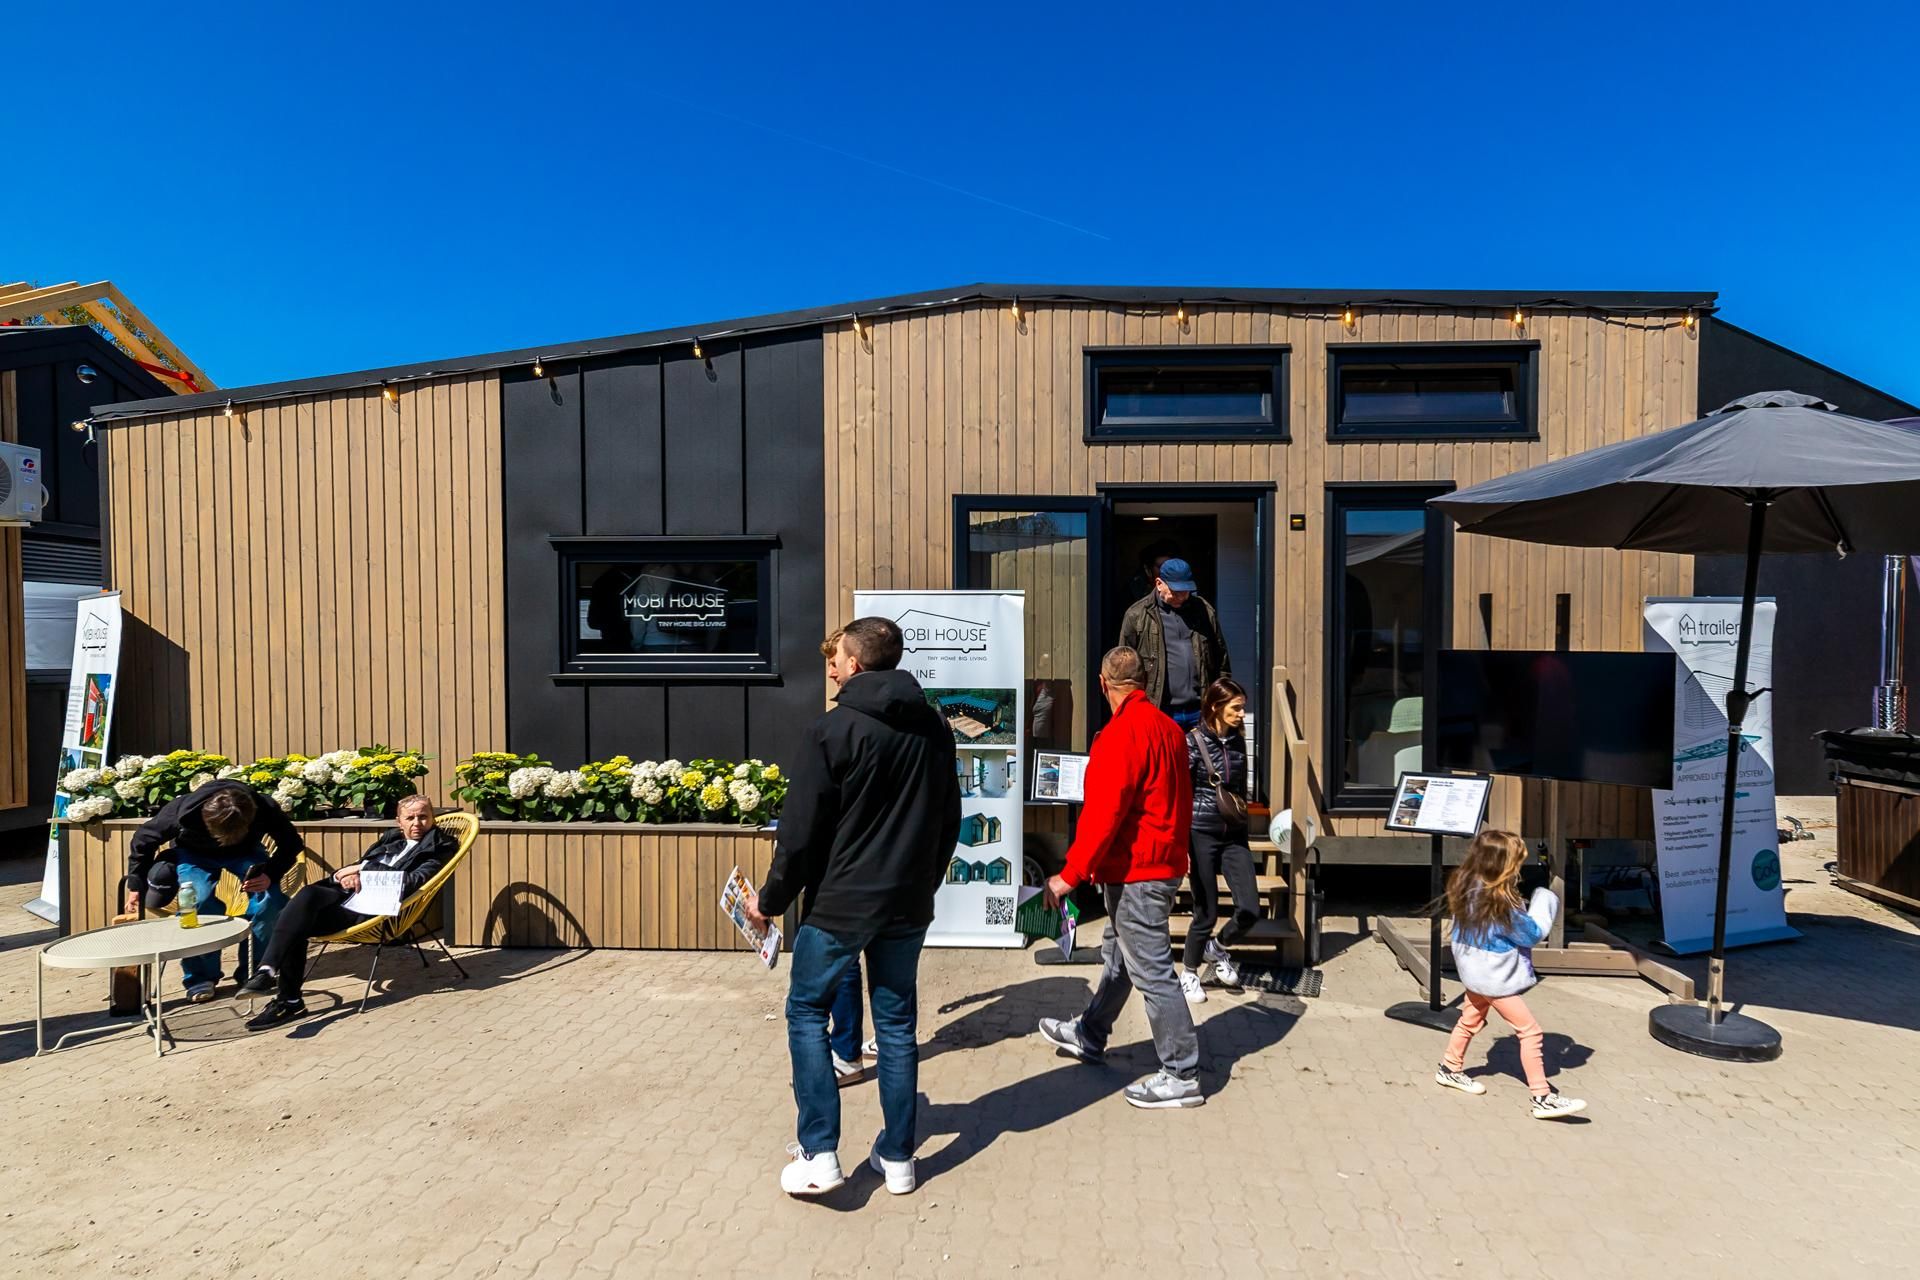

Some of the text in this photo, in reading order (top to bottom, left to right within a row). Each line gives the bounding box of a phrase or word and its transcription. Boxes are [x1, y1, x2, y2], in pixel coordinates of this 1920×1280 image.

[624, 594, 725, 608] MOBI HOUSE
[904, 628, 987, 641] OBI HOUSE
[1739, 769, 1764, 778] SYSTEM
